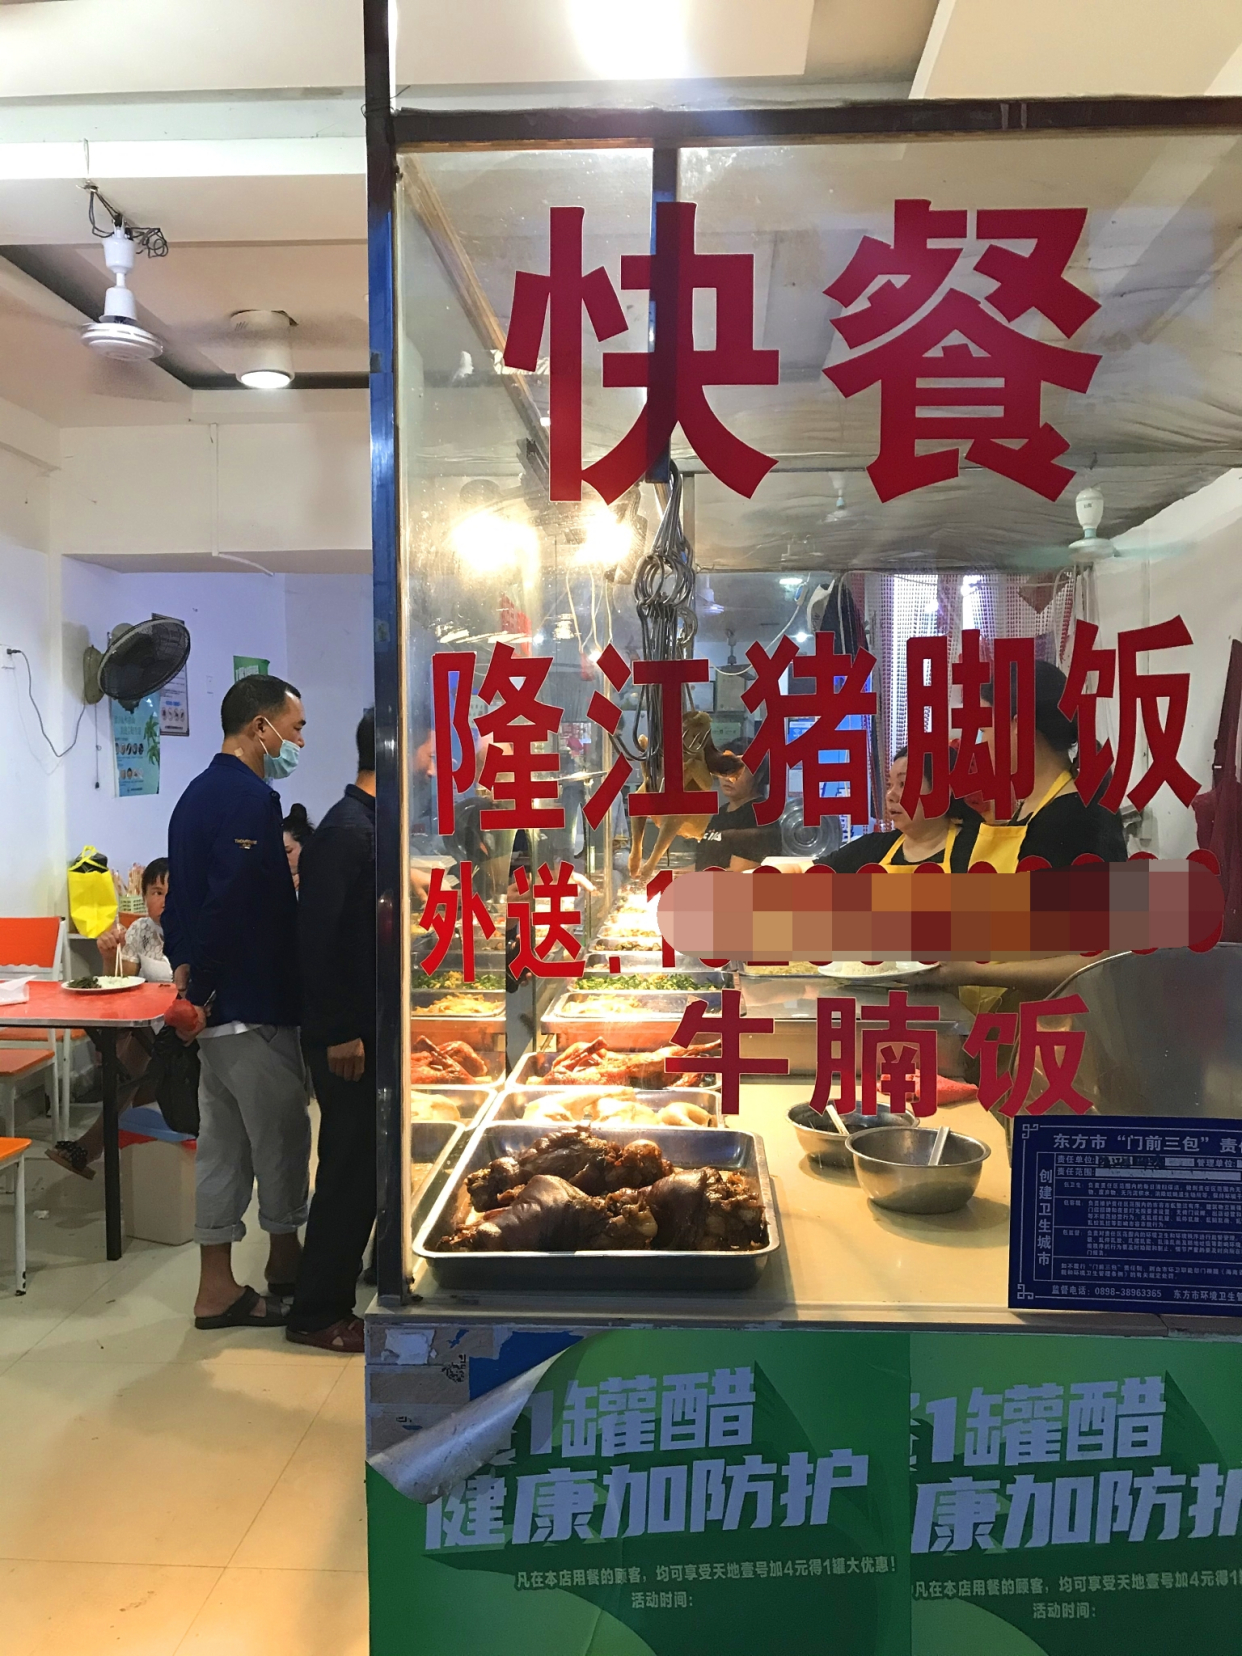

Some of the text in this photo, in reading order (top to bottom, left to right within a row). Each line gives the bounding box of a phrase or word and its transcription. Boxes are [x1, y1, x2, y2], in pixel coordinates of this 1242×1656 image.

[503, 199, 1103, 504] 快餐
[432, 614, 1202, 836] 隆江猪脚饭
[664, 990, 1095, 1118] 牛腩饭
[1053, 1133, 1242, 1153] 东方市“门前三包”责
[1037, 1169, 1053, 1266] 创建卫生城市
[1095, 1287, 1162, 1298] 0898-38963365
[488, 1367, 756, 1466] 1罐醋
[910, 1376, 1166, 1471] 1罐醋
[914, 1569, 1242, 1598] 凡在本店用餐的顾客，均可享受天地壹号加4元得1
